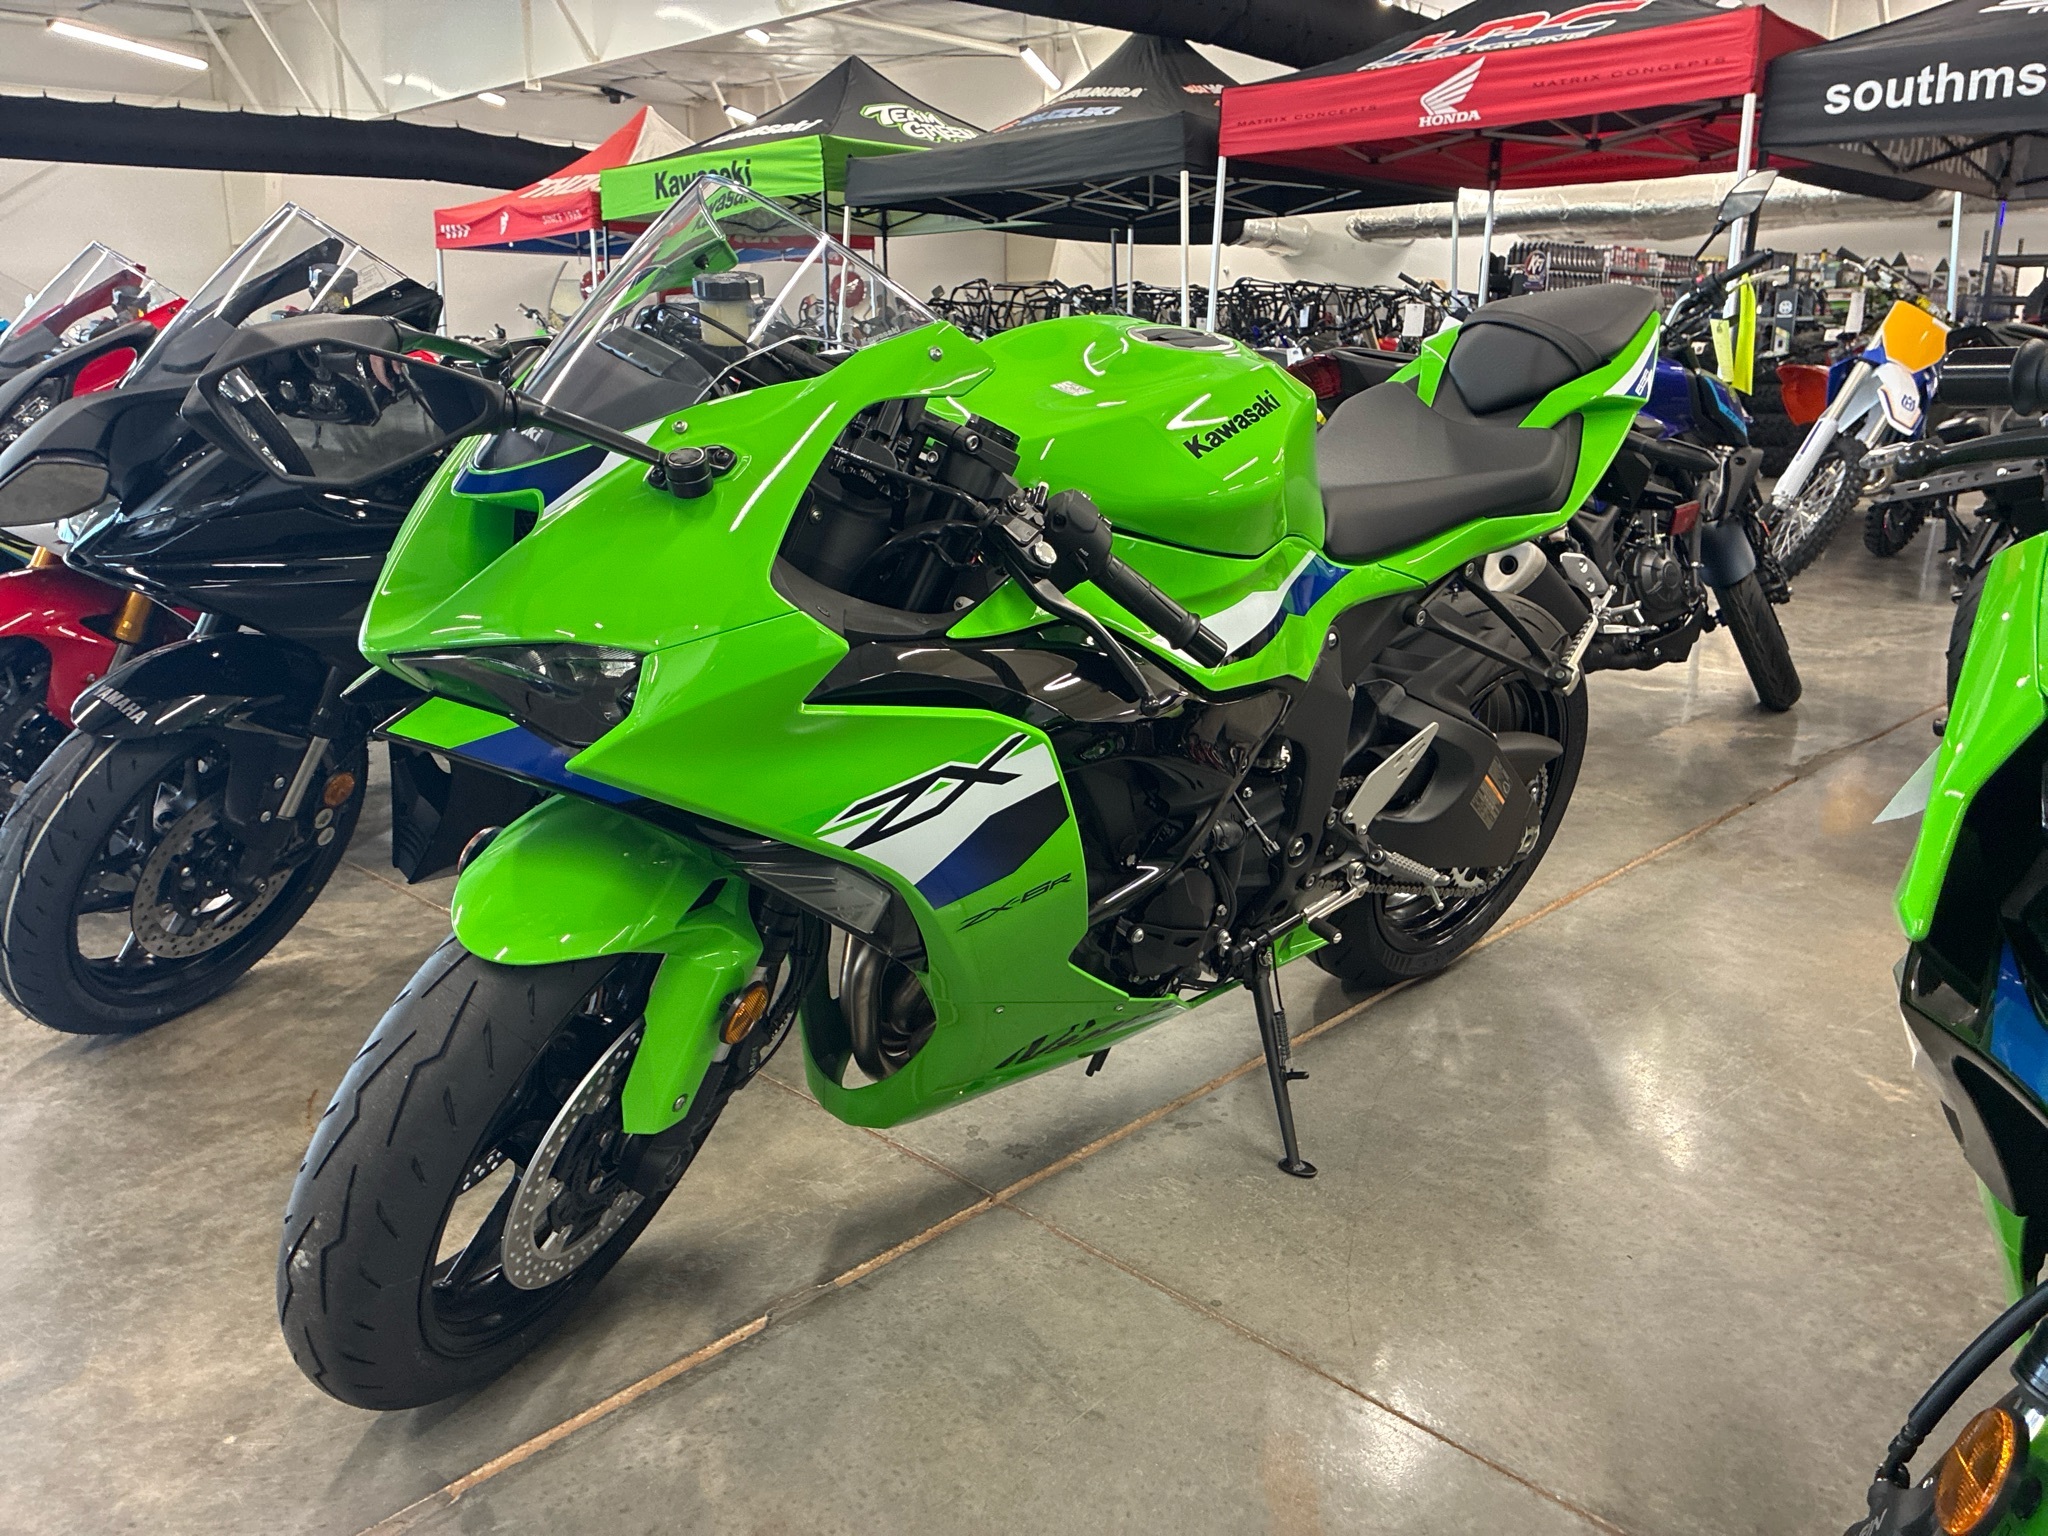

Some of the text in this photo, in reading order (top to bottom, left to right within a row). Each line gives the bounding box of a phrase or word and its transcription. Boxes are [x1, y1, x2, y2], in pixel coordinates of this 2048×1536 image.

[1532, 56, 1727, 88] MATRIX CONCEPTS
[861, 103, 945, 127] TEAM
[1237, 105, 1378, 127] MATRIX CONCEPTS
[1418, 109, 1482, 127] HONDA
[901, 121, 980, 142] GREEN
[1182, 389, 1281, 459] Kawasaki
[93, 684, 148, 725] YAMAHA
[833, 732, 1024, 851] ZX
[957, 872, 1072, 933] ZX-6R
